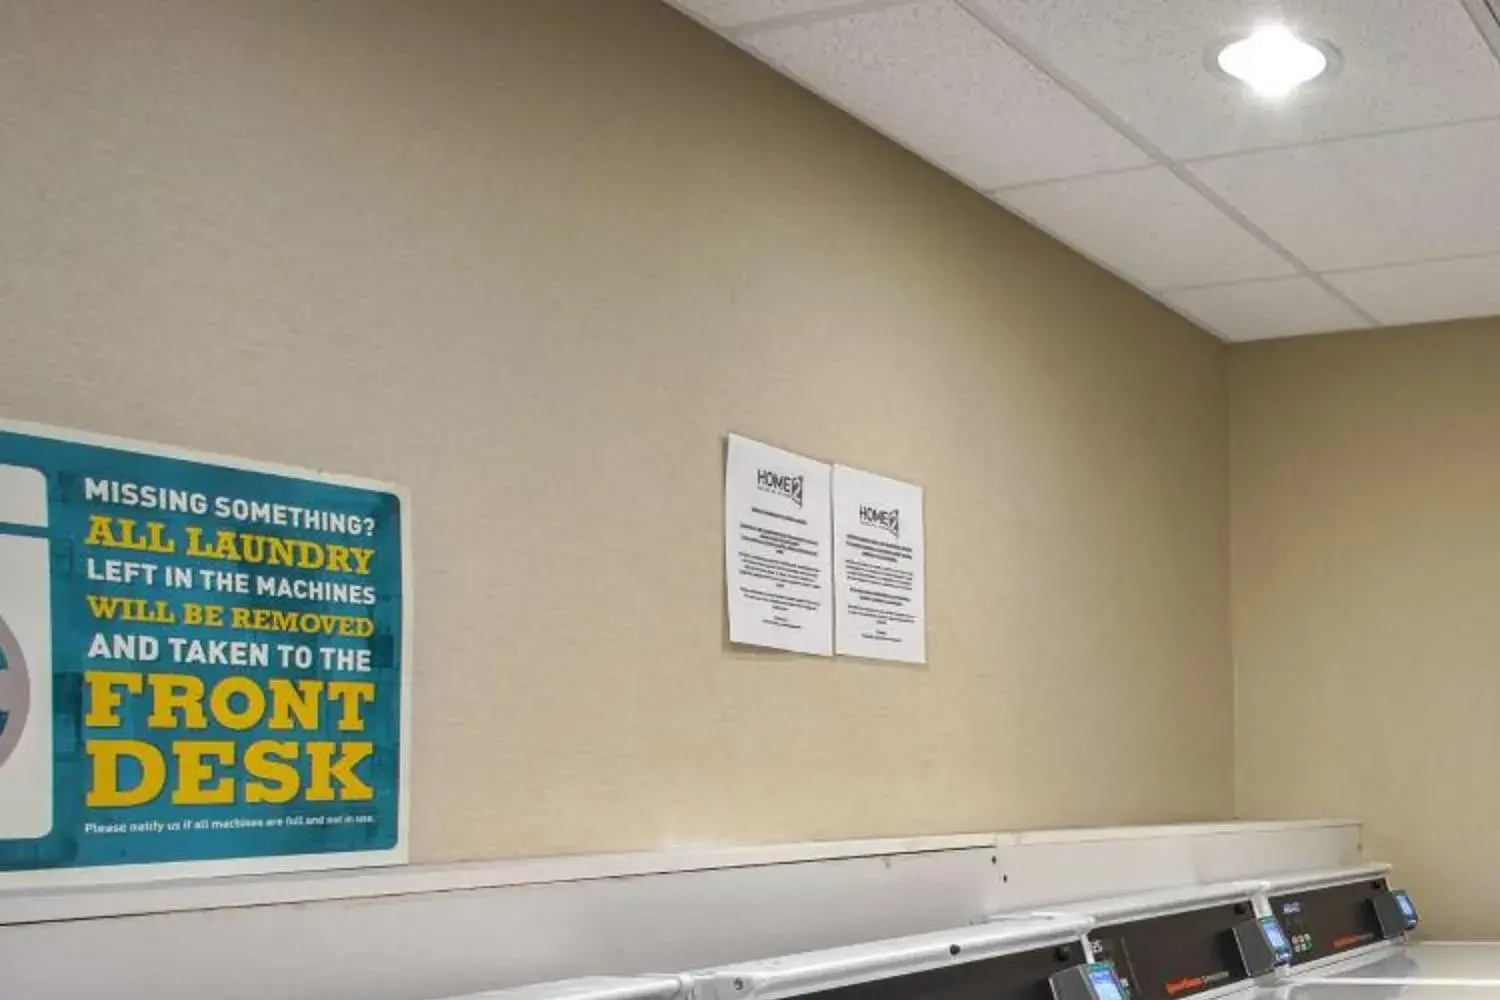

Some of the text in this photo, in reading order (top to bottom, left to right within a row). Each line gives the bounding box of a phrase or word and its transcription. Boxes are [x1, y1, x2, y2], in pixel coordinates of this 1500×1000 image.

[84, 477, 376, 536] MISSING SOMETHING?
[84, 515, 375, 575] ALL LAUNDRY
[87, 558, 376, 605] LEFT IN THE MACHINES
[86, 595, 374, 637] WILL BE REMOVED
[87, 632, 371, 672] AND TAKEN TO THE
[84, 671, 375, 732] FRONT
[85, 739, 374, 808] DESK
[85, 822, 127, 833] Please
[129, 819, 164, 833] notify
[167, 822, 181, 831] us
[183, 819, 192, 830] if
[194, 819, 209, 829] all
[211, 817, 263, 829] machines
[265, 819, 283, 828] are
[306, 815, 325, 825] and
